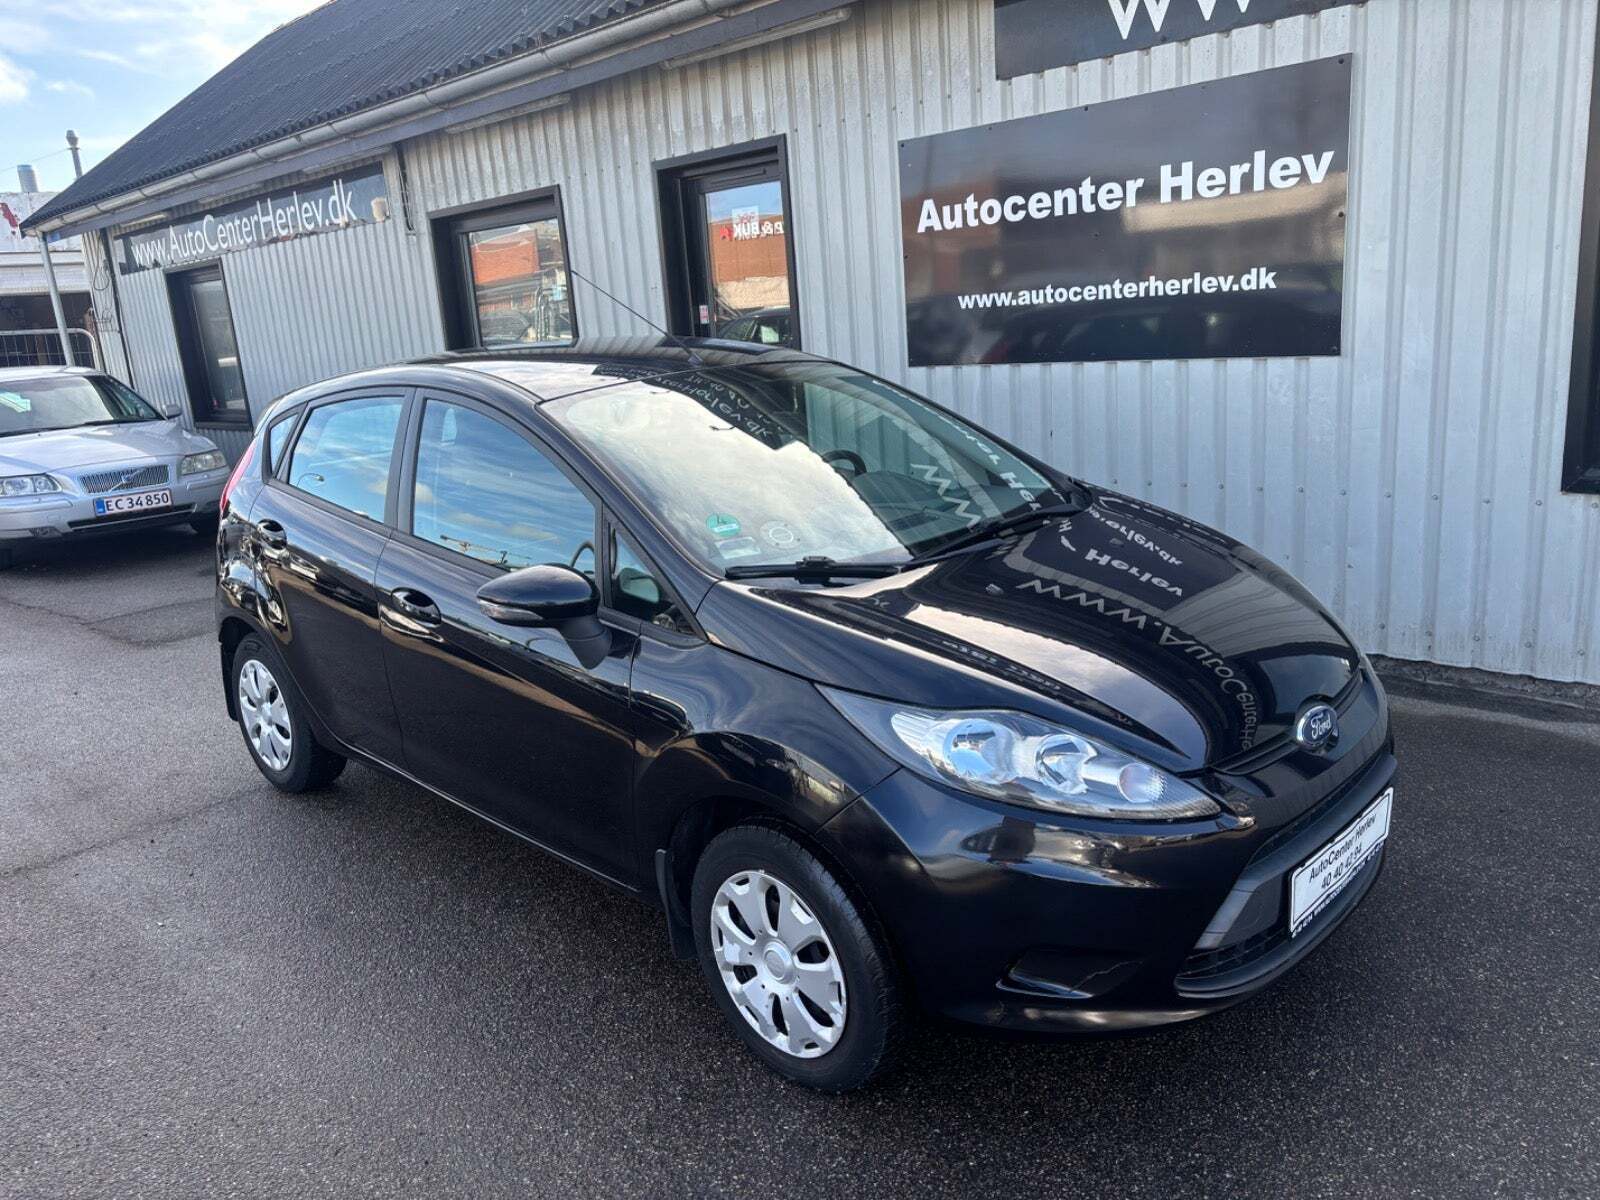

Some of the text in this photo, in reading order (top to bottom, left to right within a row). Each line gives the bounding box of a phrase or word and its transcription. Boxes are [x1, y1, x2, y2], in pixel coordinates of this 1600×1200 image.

[917, 149, 1335, 233] Autocenter Herlev
[131, 178, 358, 265] www.AutoCenterHerlev.dk
[958, 267, 1277, 310] www.autocenterherlev.dk
[105, 492, 169, 511] EC 34 850
[1310, 711, 1332, 740] Ford
[1309, 836, 1355, 883] AutoCenter
